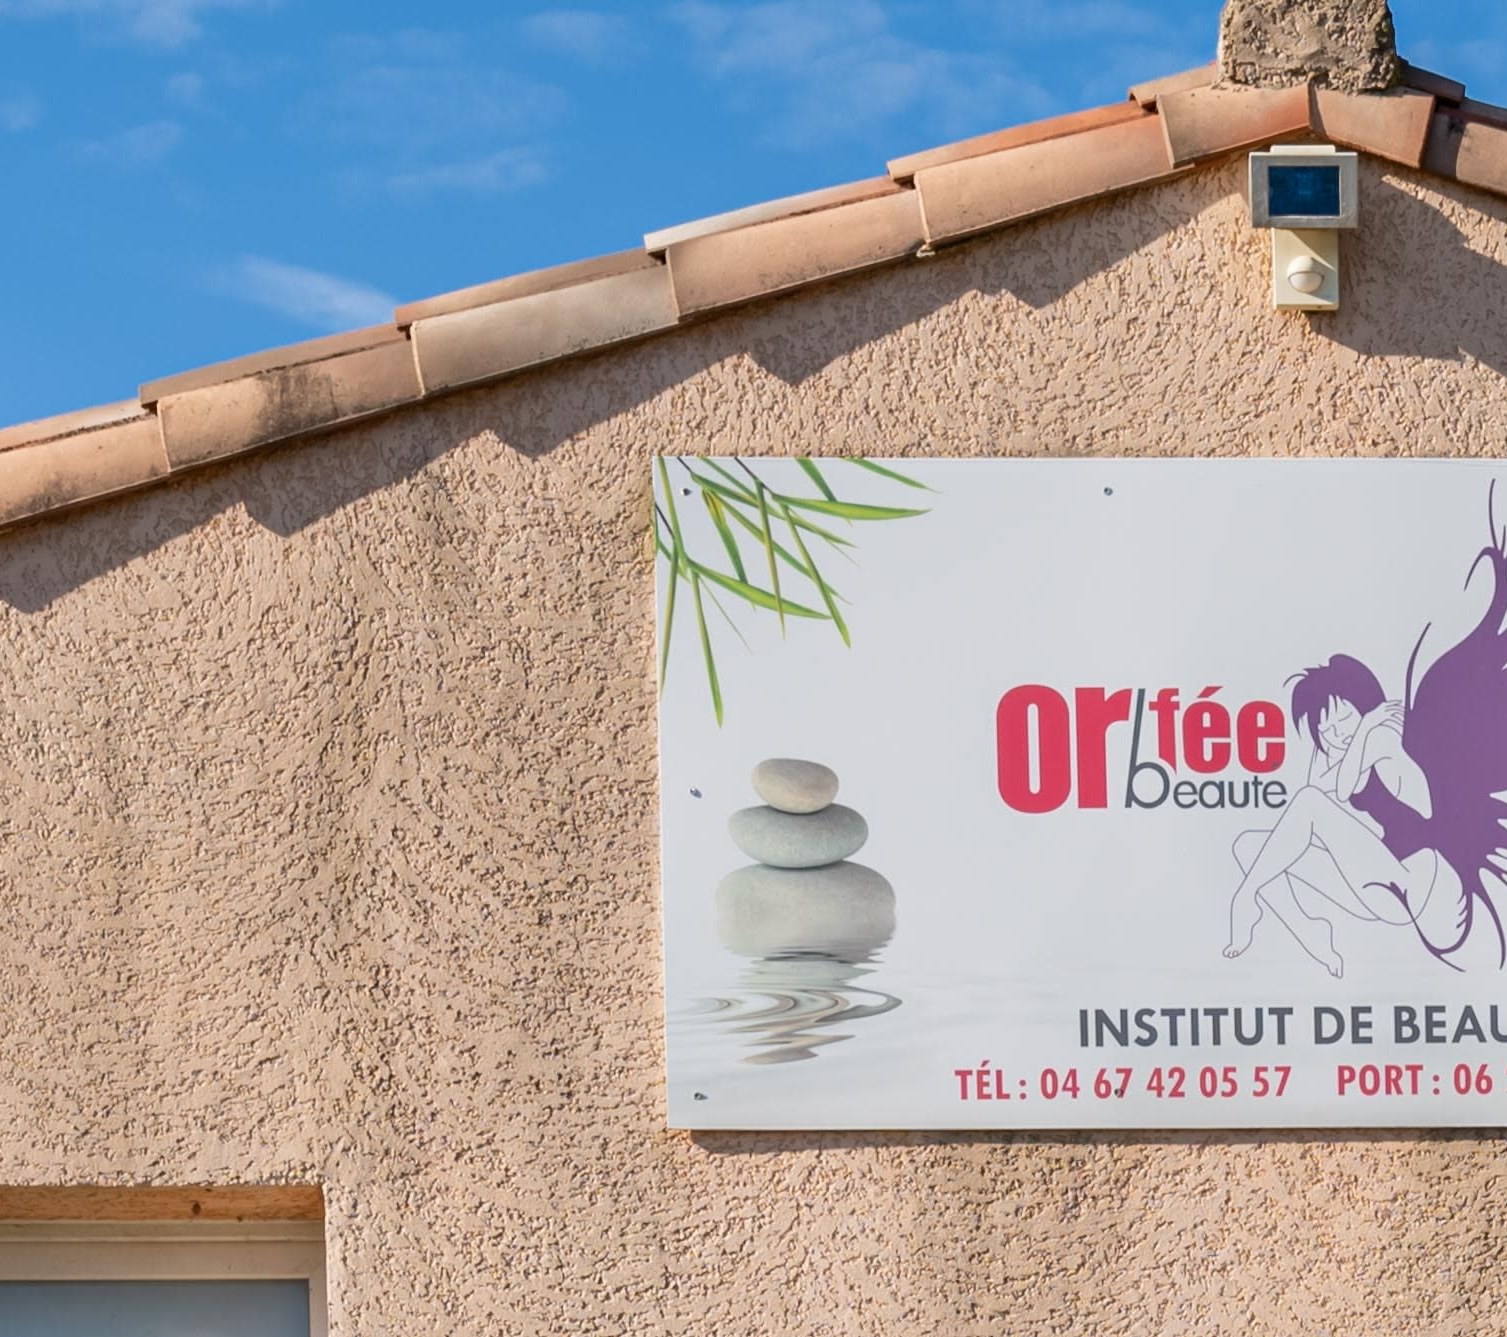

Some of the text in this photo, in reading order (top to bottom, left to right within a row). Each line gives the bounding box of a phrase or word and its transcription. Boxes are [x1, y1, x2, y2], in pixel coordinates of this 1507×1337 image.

[1079, 1007, 1294, 1047] INSTITUT
[1313, 1005, 1373, 1045] DE
[1040, 1067, 1080, 1099] 04
[1093, 1067, 1133, 1099] 67
[1146, 1067, 1186, 1099] 42
[1199, 1066, 1238, 1098] 05
[1252, 1065, 1292, 1097] 57
[1453, 1063, 1493, 1095] 06
